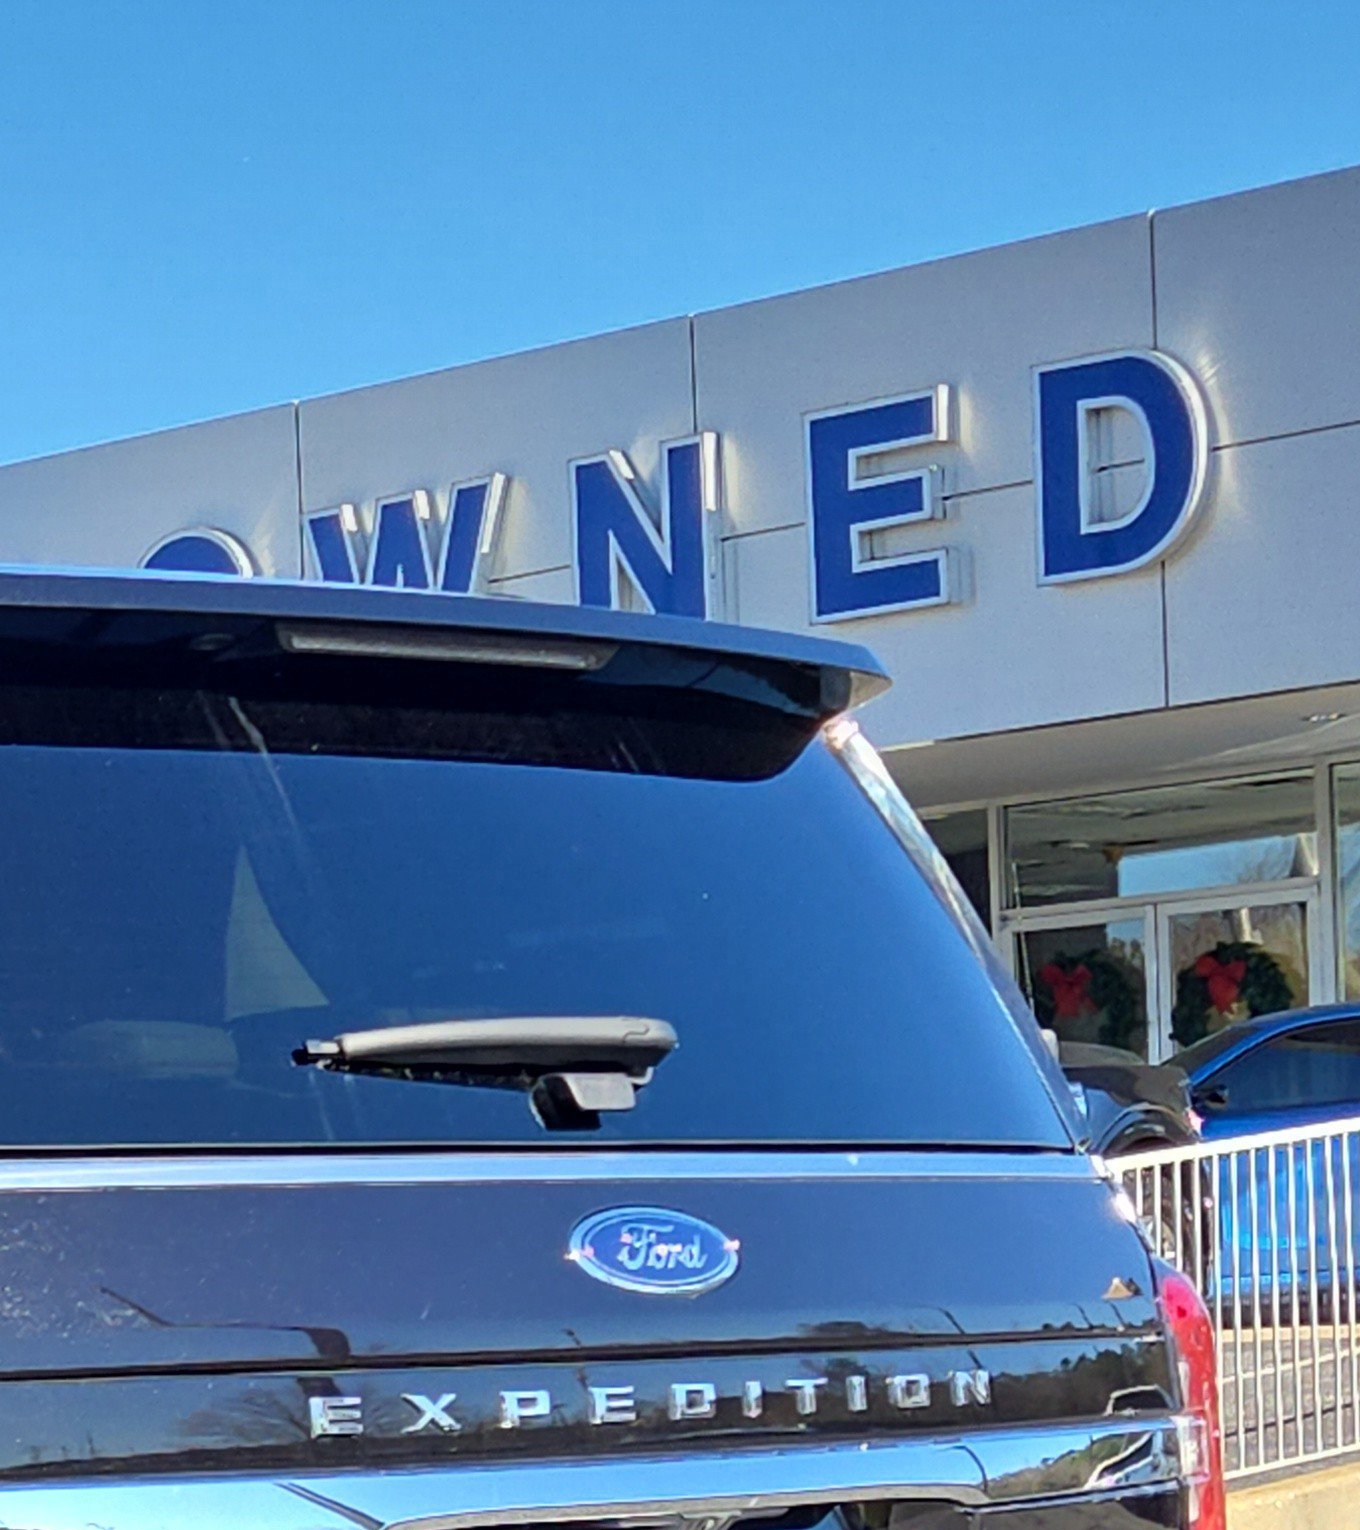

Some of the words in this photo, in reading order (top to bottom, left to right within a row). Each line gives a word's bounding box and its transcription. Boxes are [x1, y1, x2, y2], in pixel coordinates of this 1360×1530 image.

[138, 348, 1213, 625] WNED
[617, 1223, 707, 1271] Ford
[309, 1369, 991, 1438] EXPEDITION
